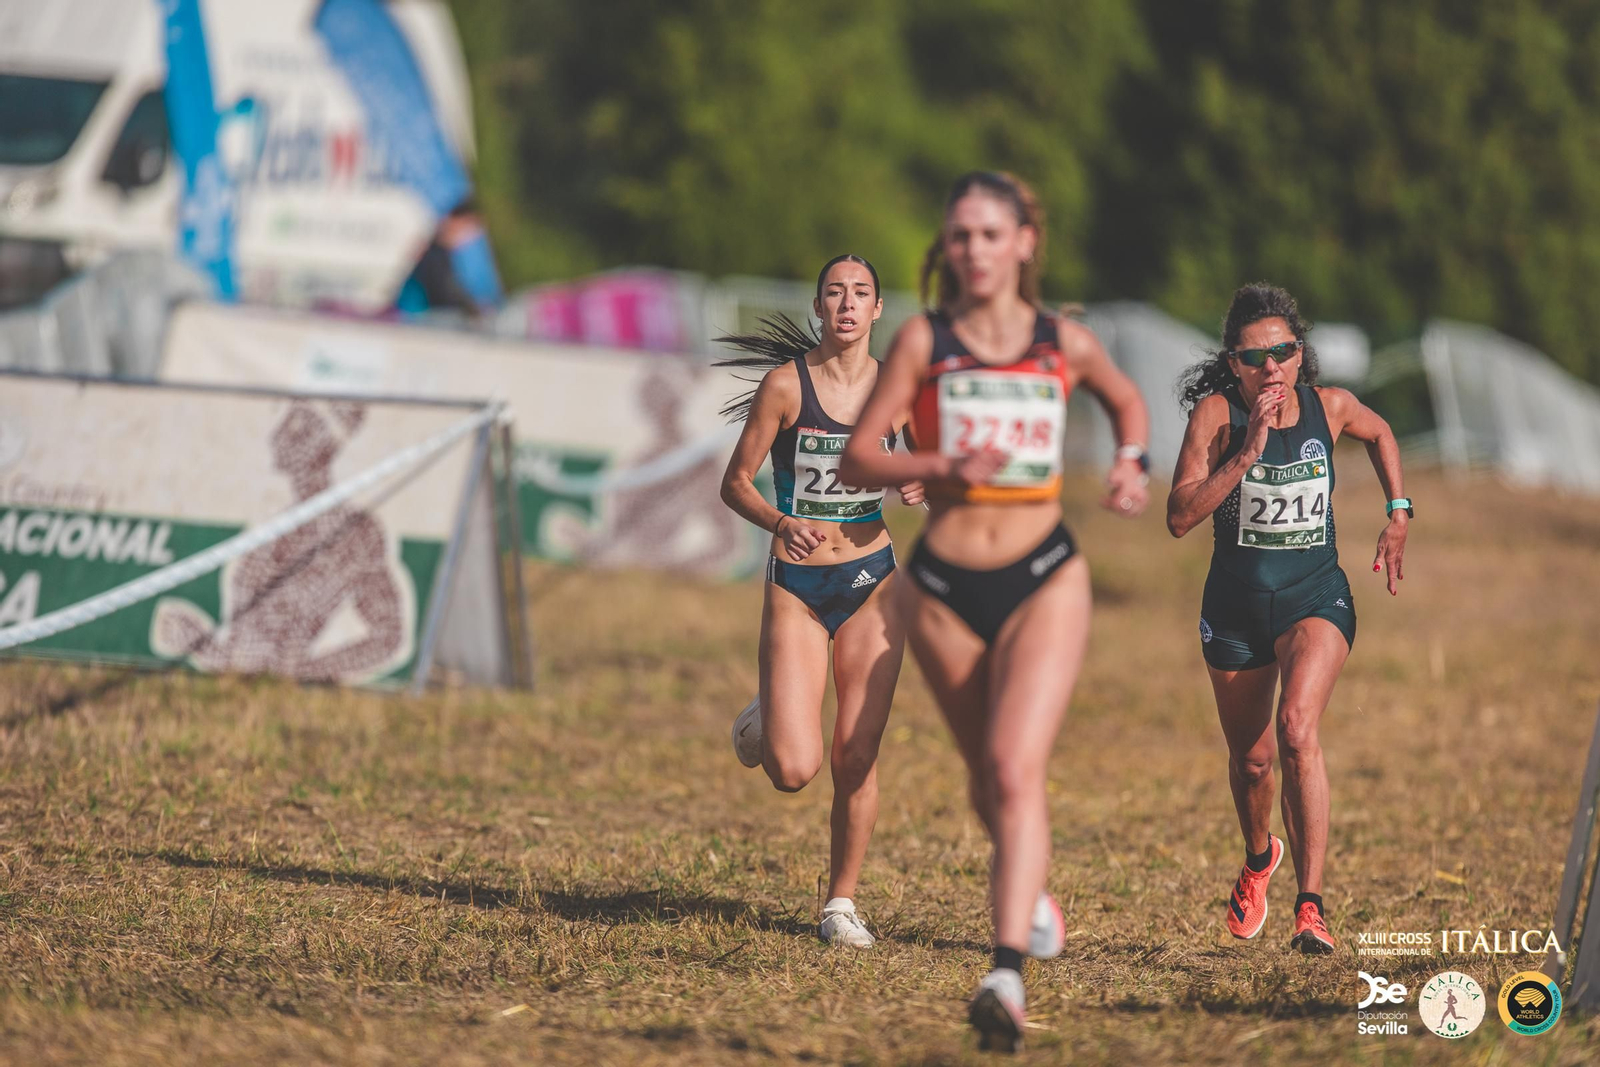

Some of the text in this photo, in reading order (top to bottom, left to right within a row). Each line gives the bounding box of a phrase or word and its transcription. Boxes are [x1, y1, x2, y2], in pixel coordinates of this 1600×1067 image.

[1271, 465, 1310, 481] ITÁLICA
[1250, 492, 1324, 525] 2214
[851, 576, 877, 589] adidas
